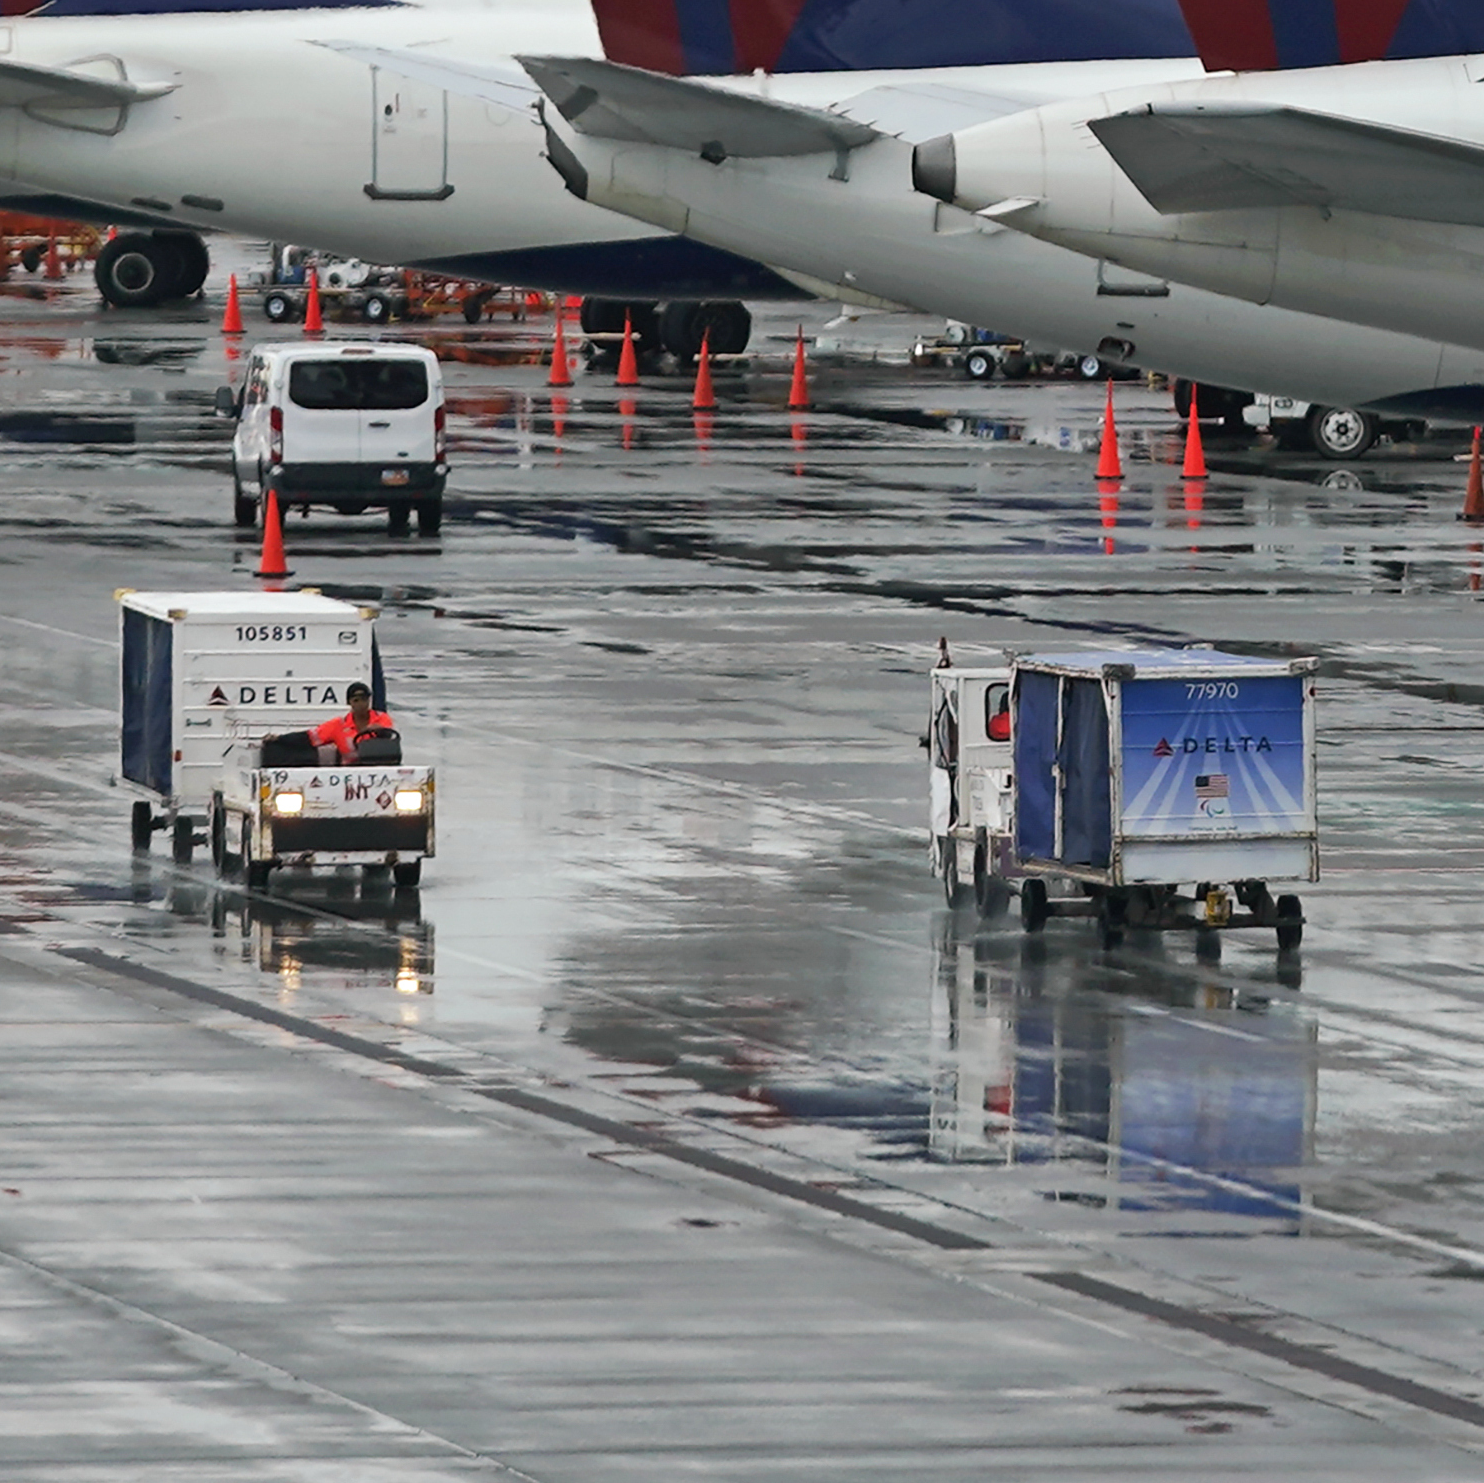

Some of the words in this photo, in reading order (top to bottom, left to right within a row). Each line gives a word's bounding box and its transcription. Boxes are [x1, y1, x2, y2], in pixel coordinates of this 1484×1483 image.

[236, 625, 307, 642] 105851
[239, 685, 339, 705] DELTA
[1185, 681, 1239, 700] 77970
[1182, 736, 1273, 754] DELTA
